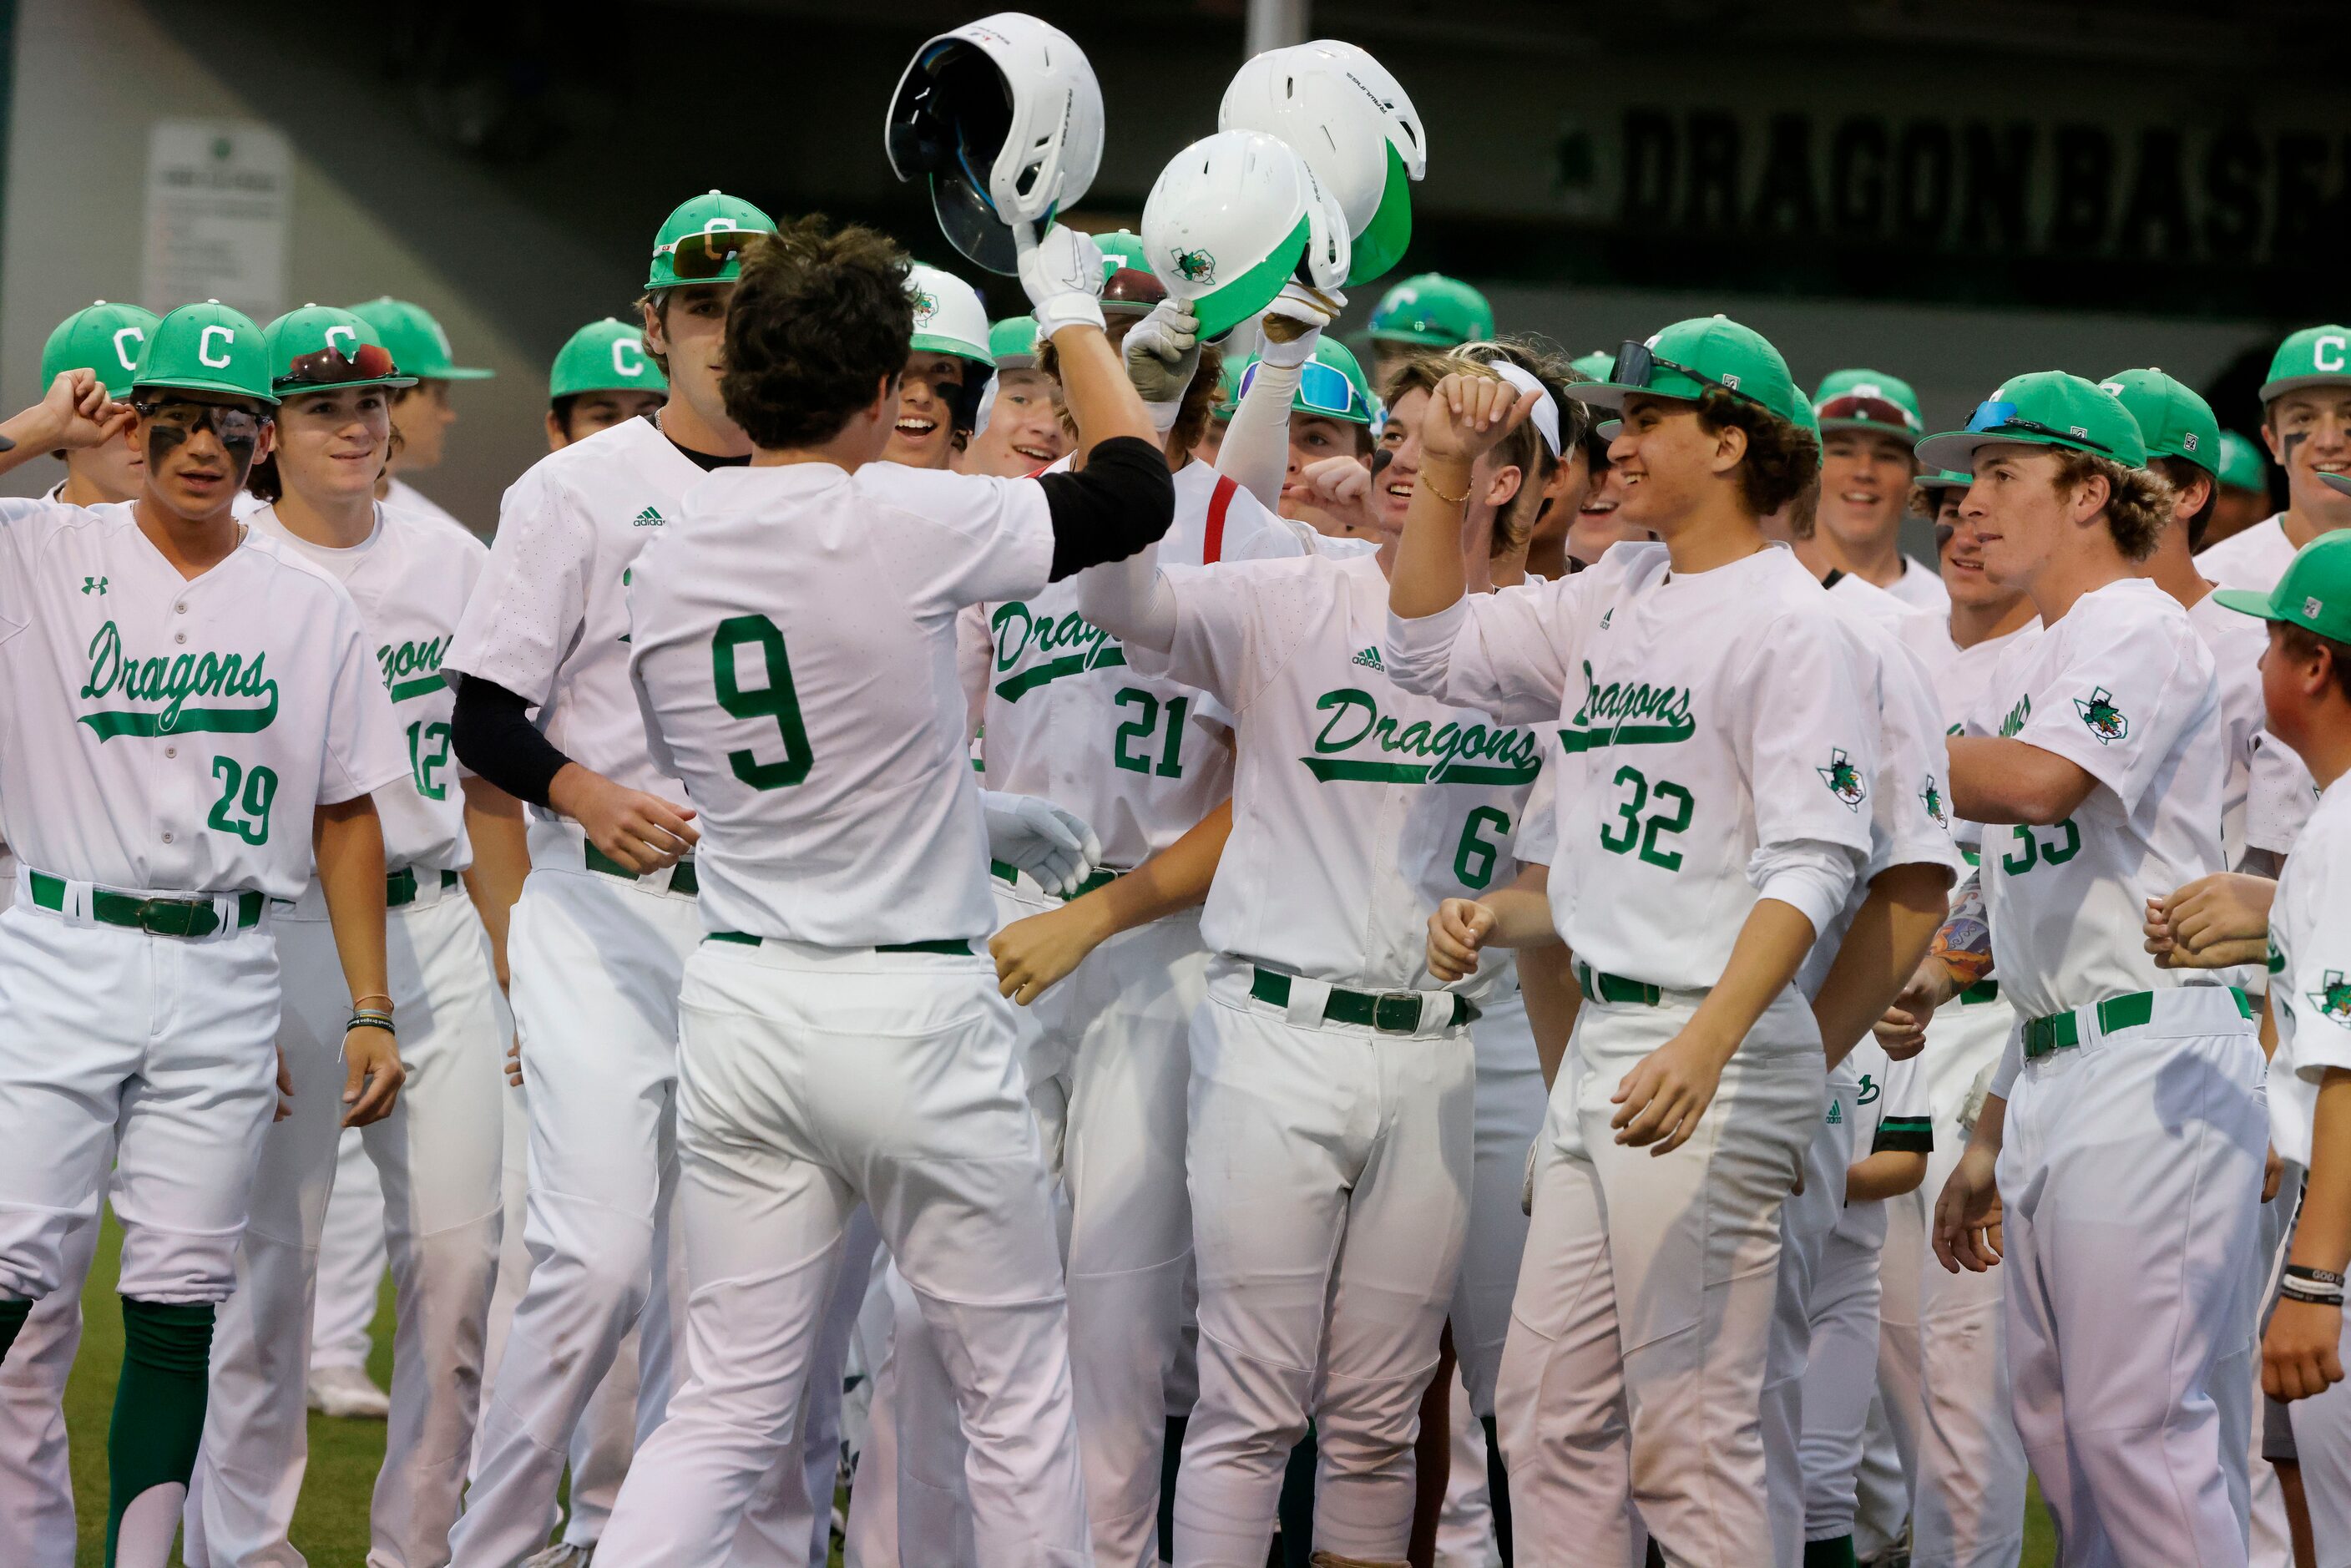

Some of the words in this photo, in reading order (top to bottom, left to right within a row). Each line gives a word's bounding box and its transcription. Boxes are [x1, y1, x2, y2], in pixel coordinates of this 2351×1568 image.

[1346, 72, 1388, 114] RAWLINGS
[1622, 105, 2035, 240] DRAGON
[2056, 119, 2351, 259] BASE
[704, 218, 736, 260] C
[113, 326, 144, 370] C
[199, 326, 235, 367] C
[612, 338, 644, 376] C
[2313, 336, 2346, 372] C
[634, 518, 666, 527] adida
[992, 601, 1109, 672] Drag
[1352, 656, 1385, 672] adidas
[79, 620, 278, 732] Dragons
[712, 614, 814, 792] 9
[407, 721, 451, 802] 12
[1115, 687, 1186, 778] 21
[1314, 688, 1542, 781] Dragons
[207, 755, 279, 846] 29
[1600, 765, 1696, 873] 32
[1454, 805, 1510, 891] 6
[2312, 1269, 2335, 1283] GOD
